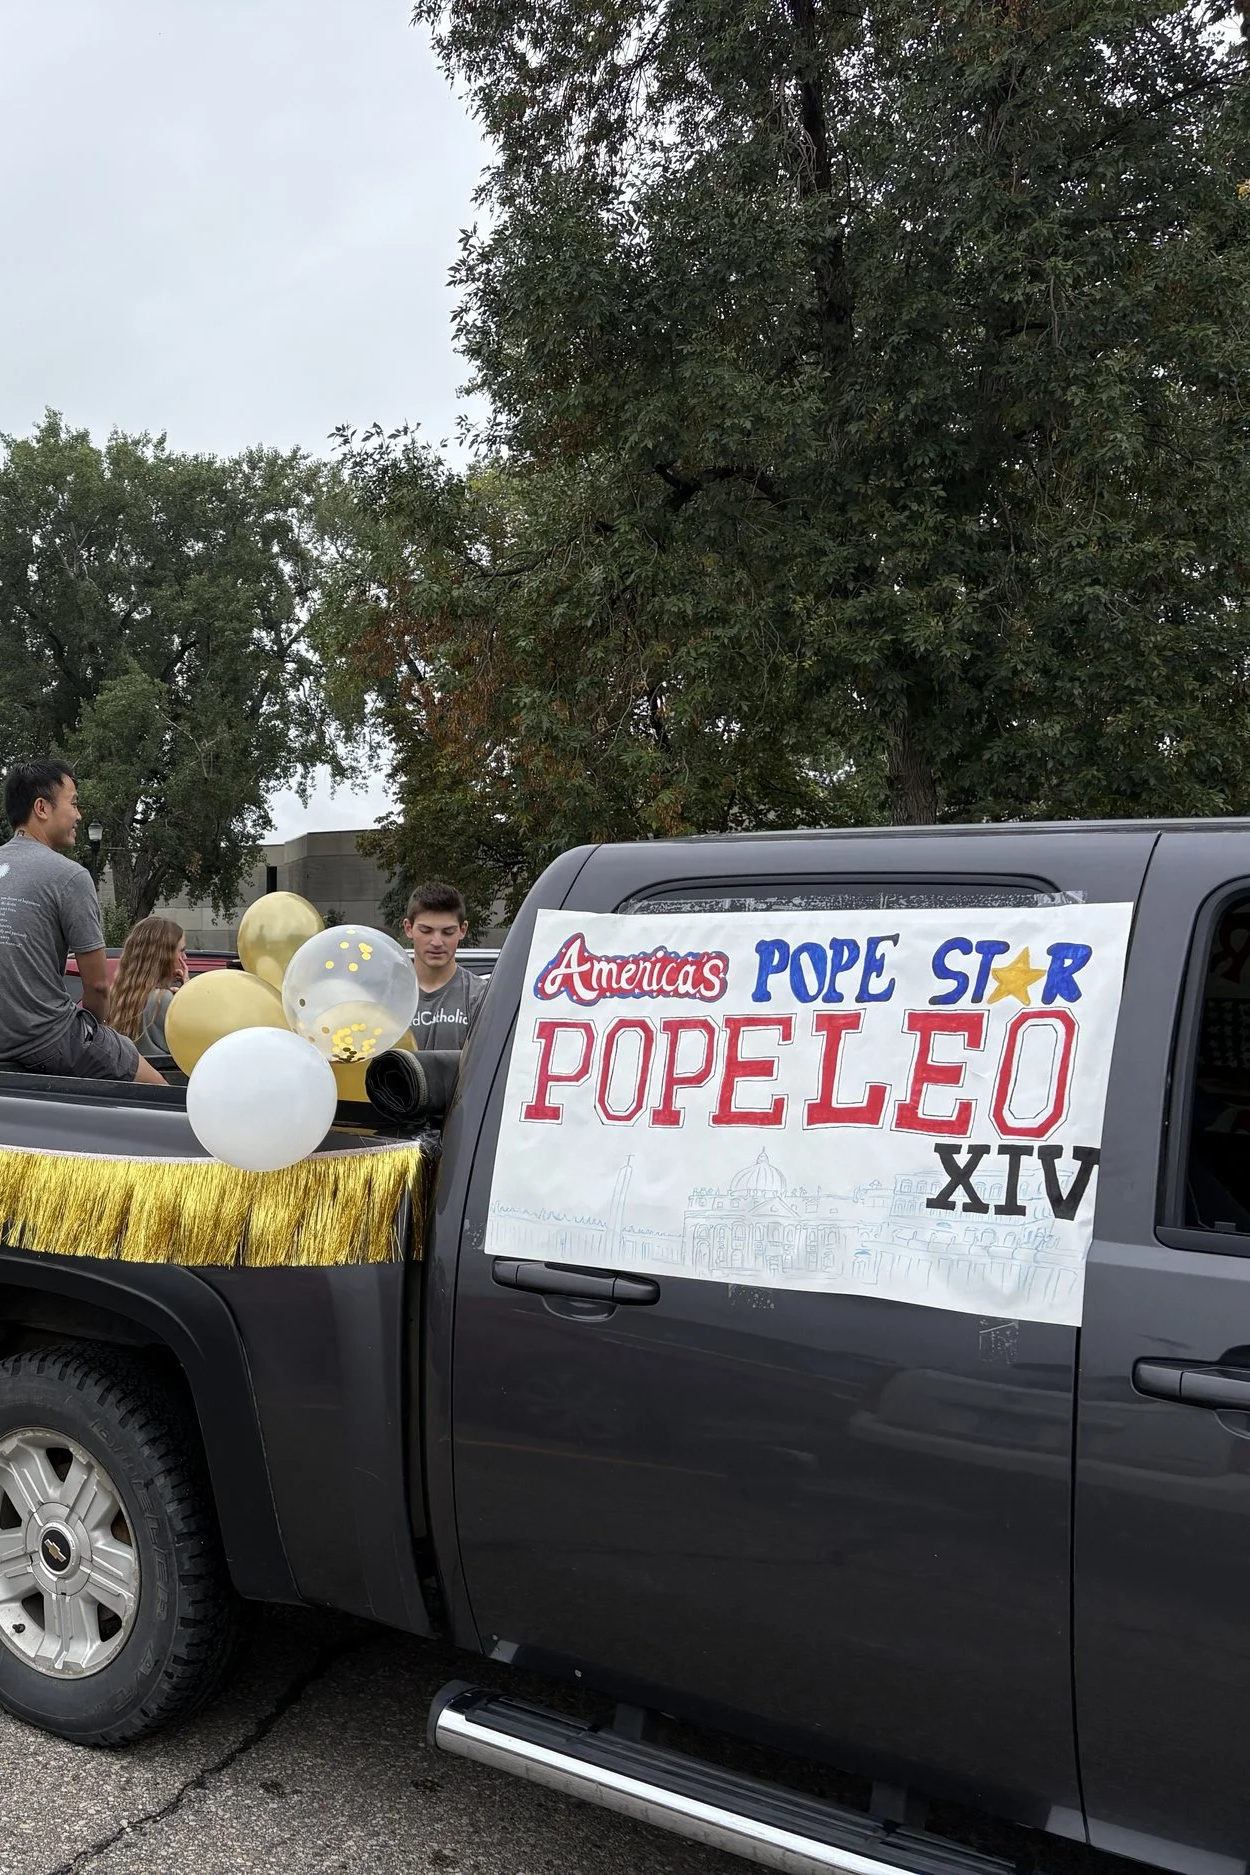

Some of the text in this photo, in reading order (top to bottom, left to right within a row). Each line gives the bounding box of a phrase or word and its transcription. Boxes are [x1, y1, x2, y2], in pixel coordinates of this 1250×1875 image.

[536, 933, 728, 1003] America's
[751, 932, 900, 1004] POPE
[410, 1008, 468, 1027] dCatholic
[925, 1143, 1100, 1221] XIV
